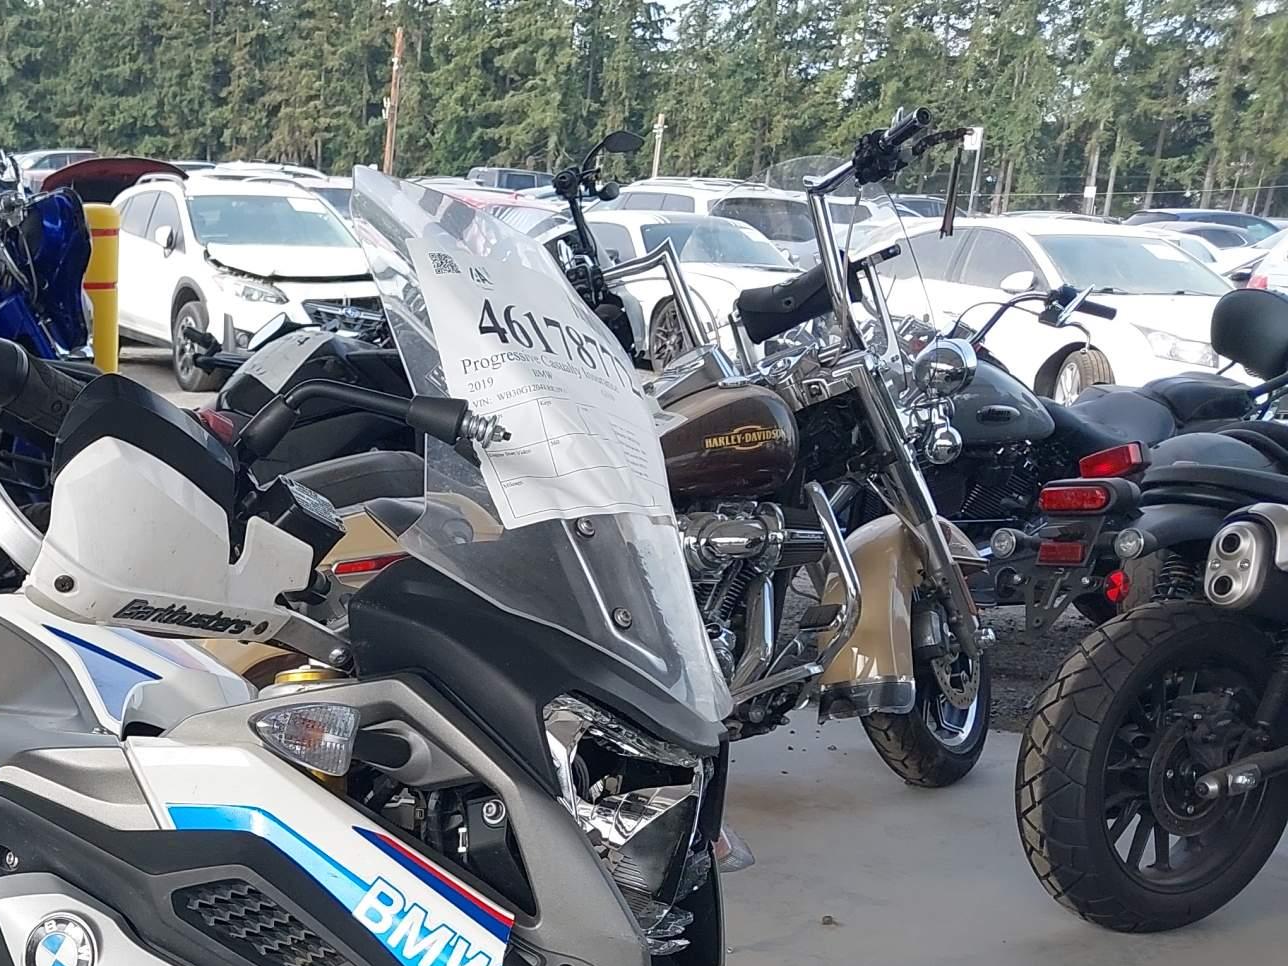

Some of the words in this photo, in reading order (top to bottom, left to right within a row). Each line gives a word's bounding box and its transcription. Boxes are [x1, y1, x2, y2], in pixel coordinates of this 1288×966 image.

[462, 351, 541, 375] Progressive
[479, 299, 644, 400] 46178772
[468, 377, 494, 393] 2019
[44, 920, 90, 961] BMW
